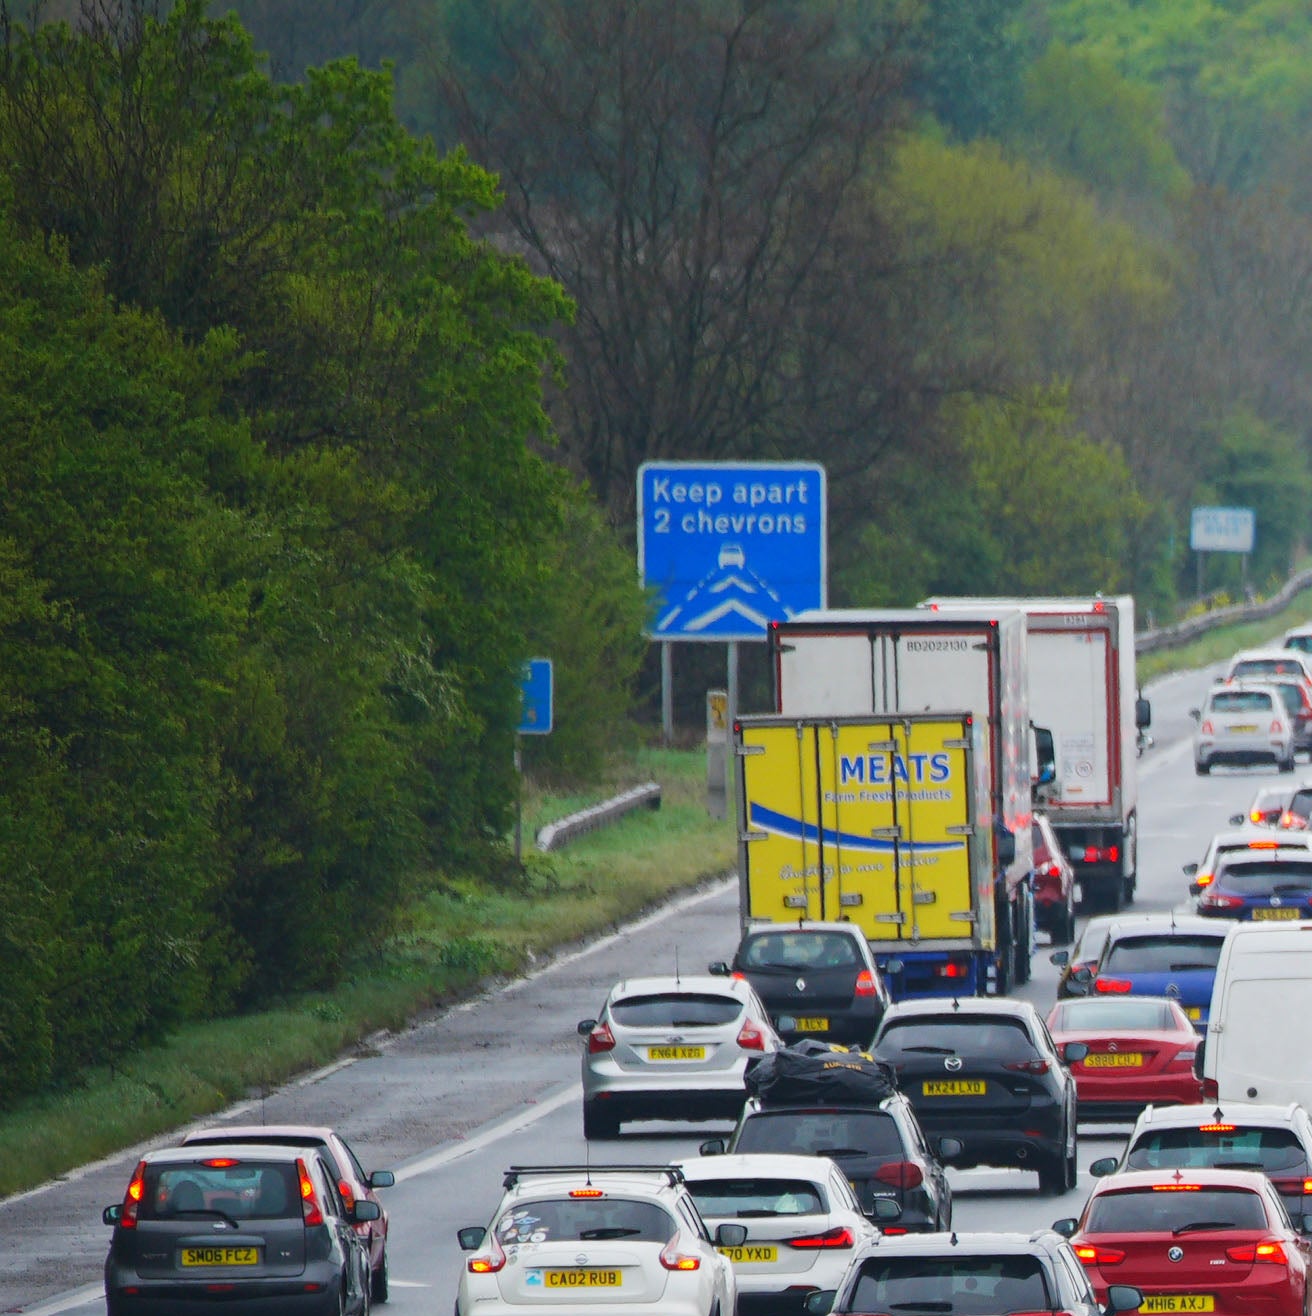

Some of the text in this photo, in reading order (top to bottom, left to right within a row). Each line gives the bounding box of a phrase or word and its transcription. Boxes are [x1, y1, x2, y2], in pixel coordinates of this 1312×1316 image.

[653, 478, 808, 508] Keep apart
[654, 509, 806, 534] 2 chevrons
[907, 640, 968, 652] BD2022130
[840, 753, 950, 784] MEATS
[825, 788, 951, 803] Farm Fresh Products
[187, 1249, 252, 1263] SM06 FCZ
[745, 1248, 771, 1260] YXD
[550, 1271, 617, 1286] CA02 RUB
[1147, 1298, 1206, 1310] WH16 AXJ
